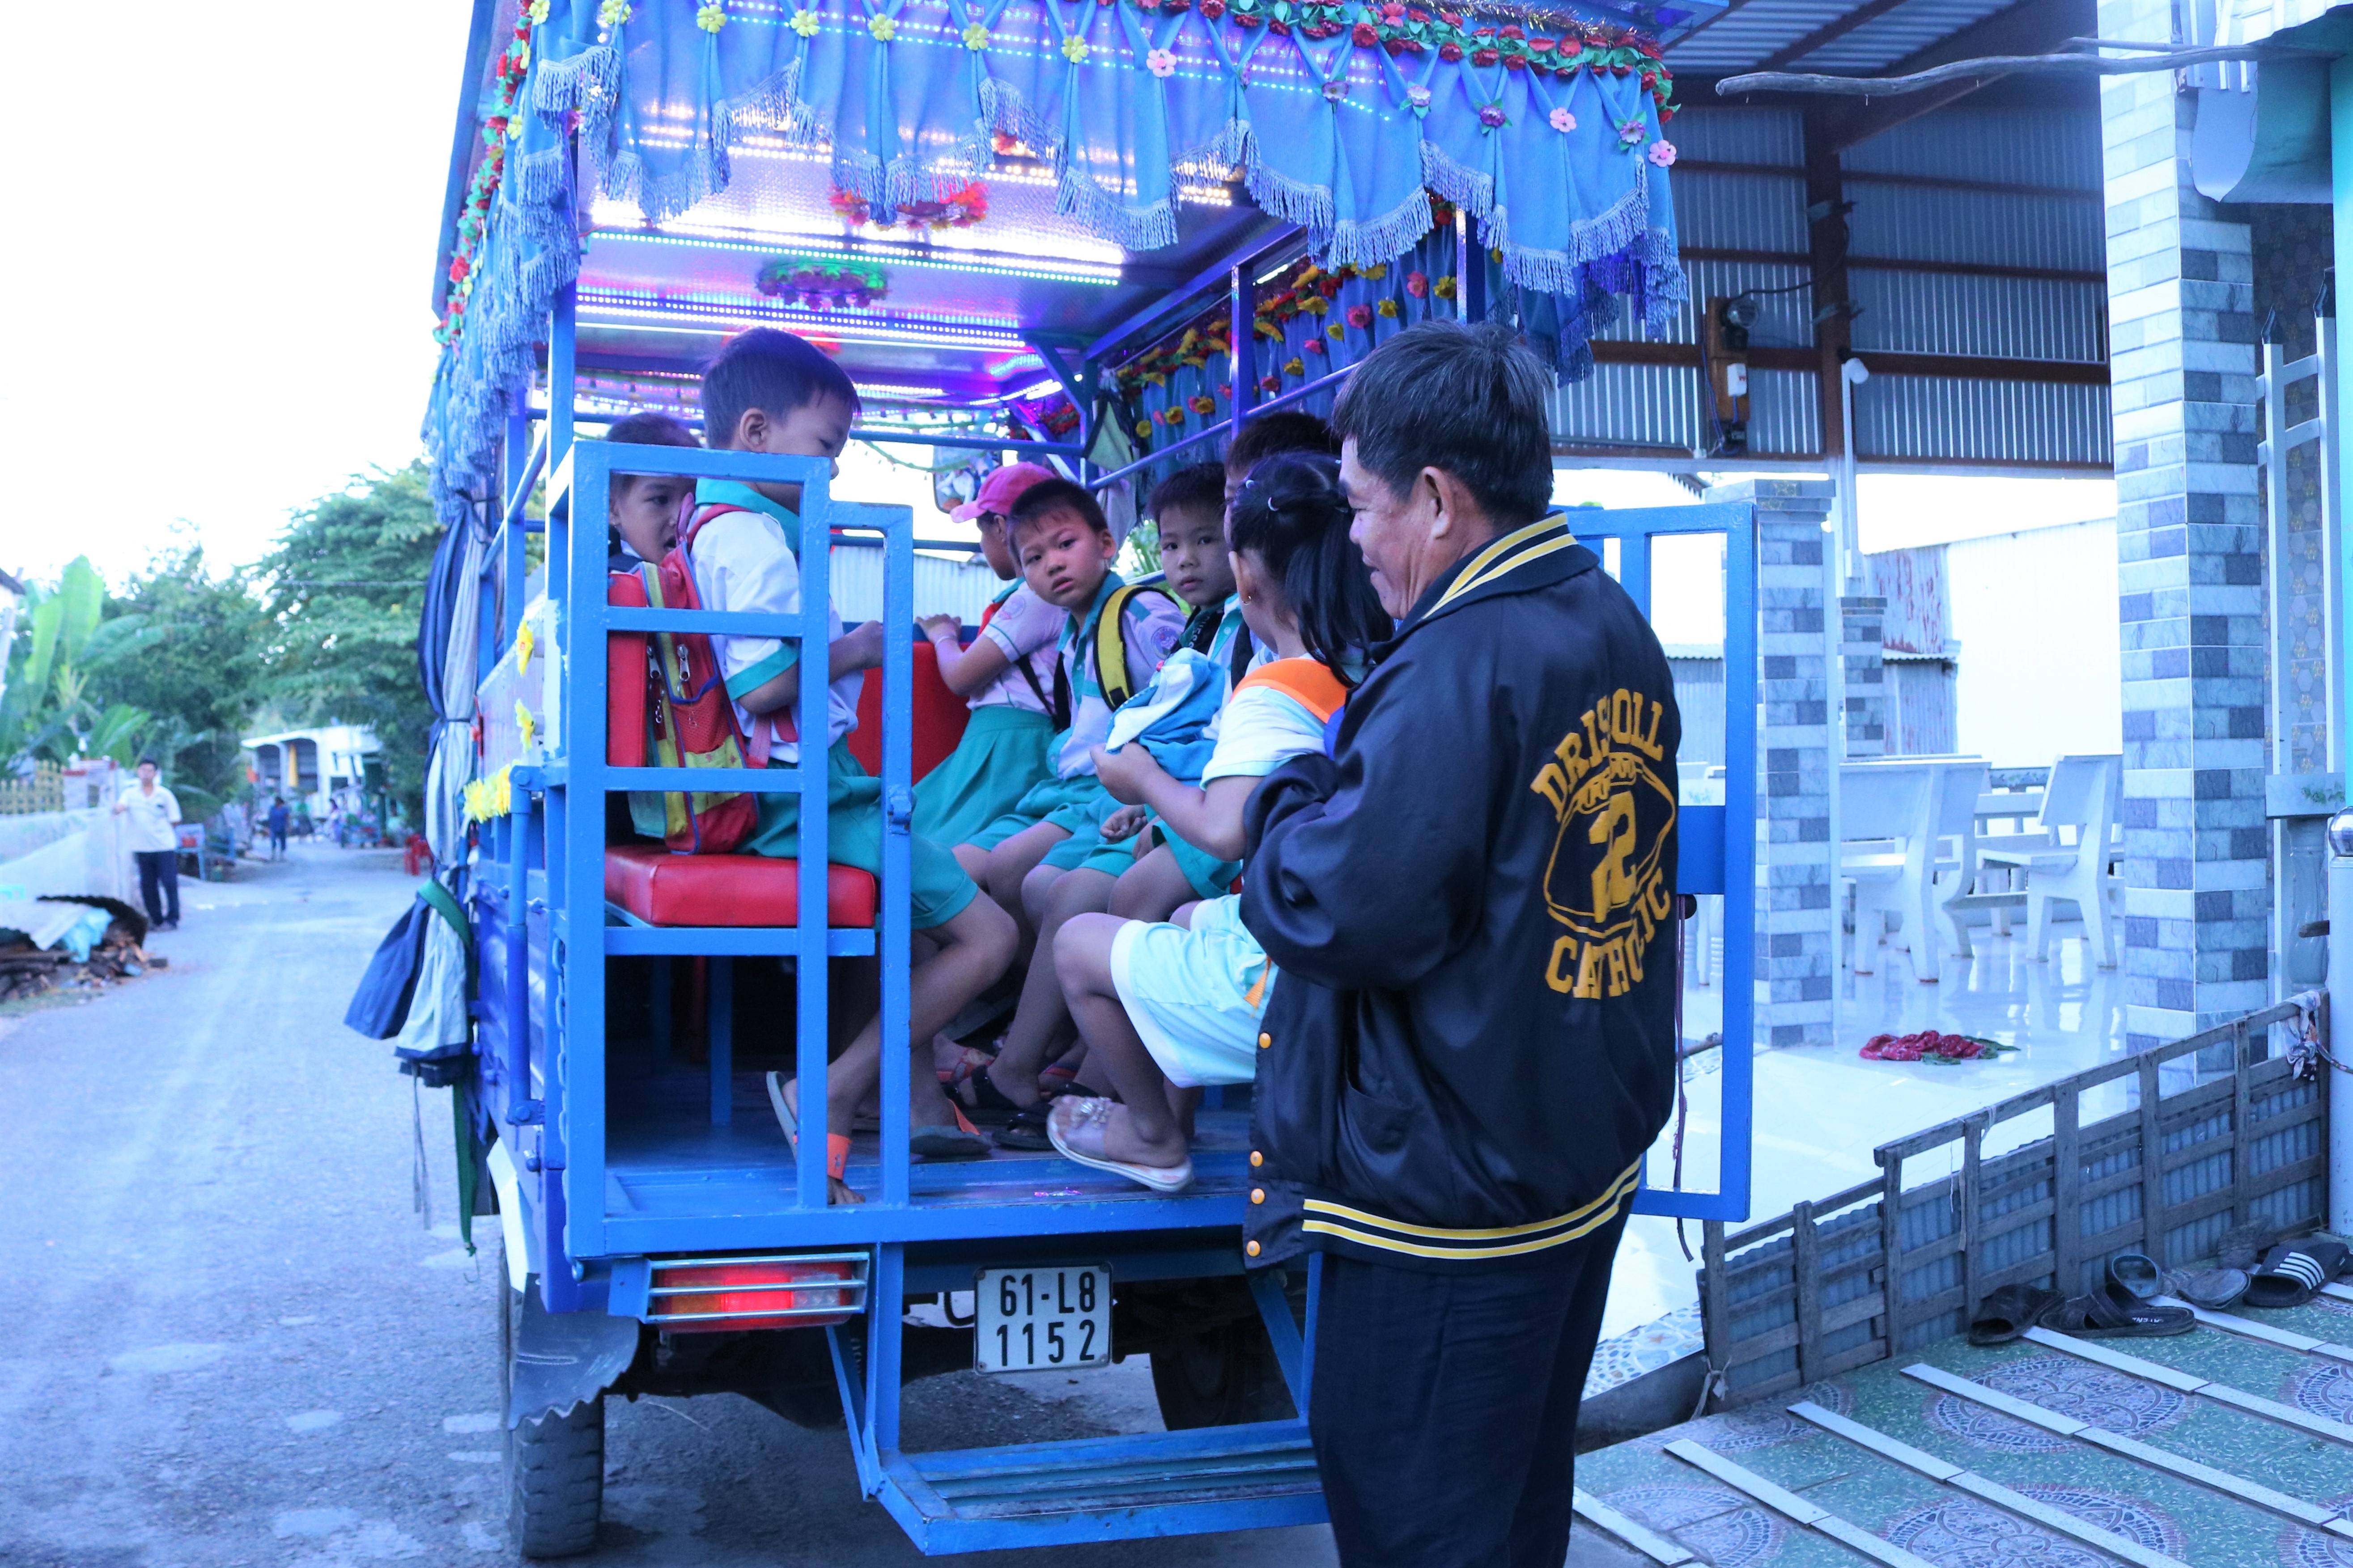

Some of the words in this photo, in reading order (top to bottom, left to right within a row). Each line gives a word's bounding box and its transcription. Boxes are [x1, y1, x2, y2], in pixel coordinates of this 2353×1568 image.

[1588, 790, 1637, 924] 2
[1000, 1271, 1095, 1317] 61-L8
[996, 1319, 1095, 1366] 1152
